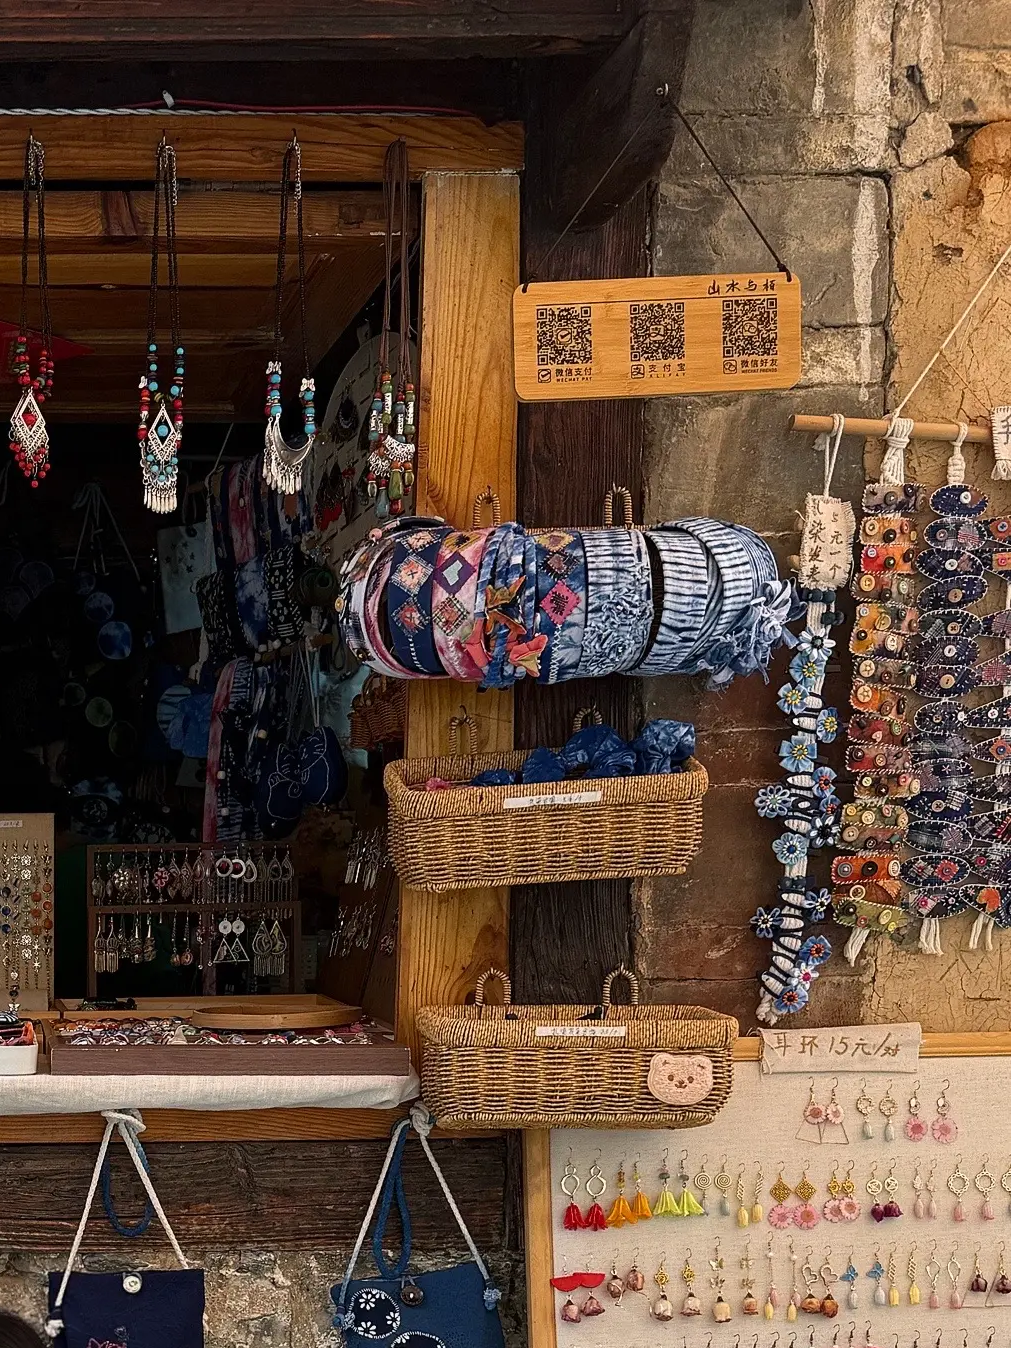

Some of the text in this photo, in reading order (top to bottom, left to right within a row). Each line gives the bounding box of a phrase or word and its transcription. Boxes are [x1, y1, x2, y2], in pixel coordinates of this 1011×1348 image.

[648, 363, 686, 373] 支付宝
[740, 358, 778, 368] 微信好友
[555, 367, 592, 377] 微信支付
[829, 512, 844, 580] 5元一个
